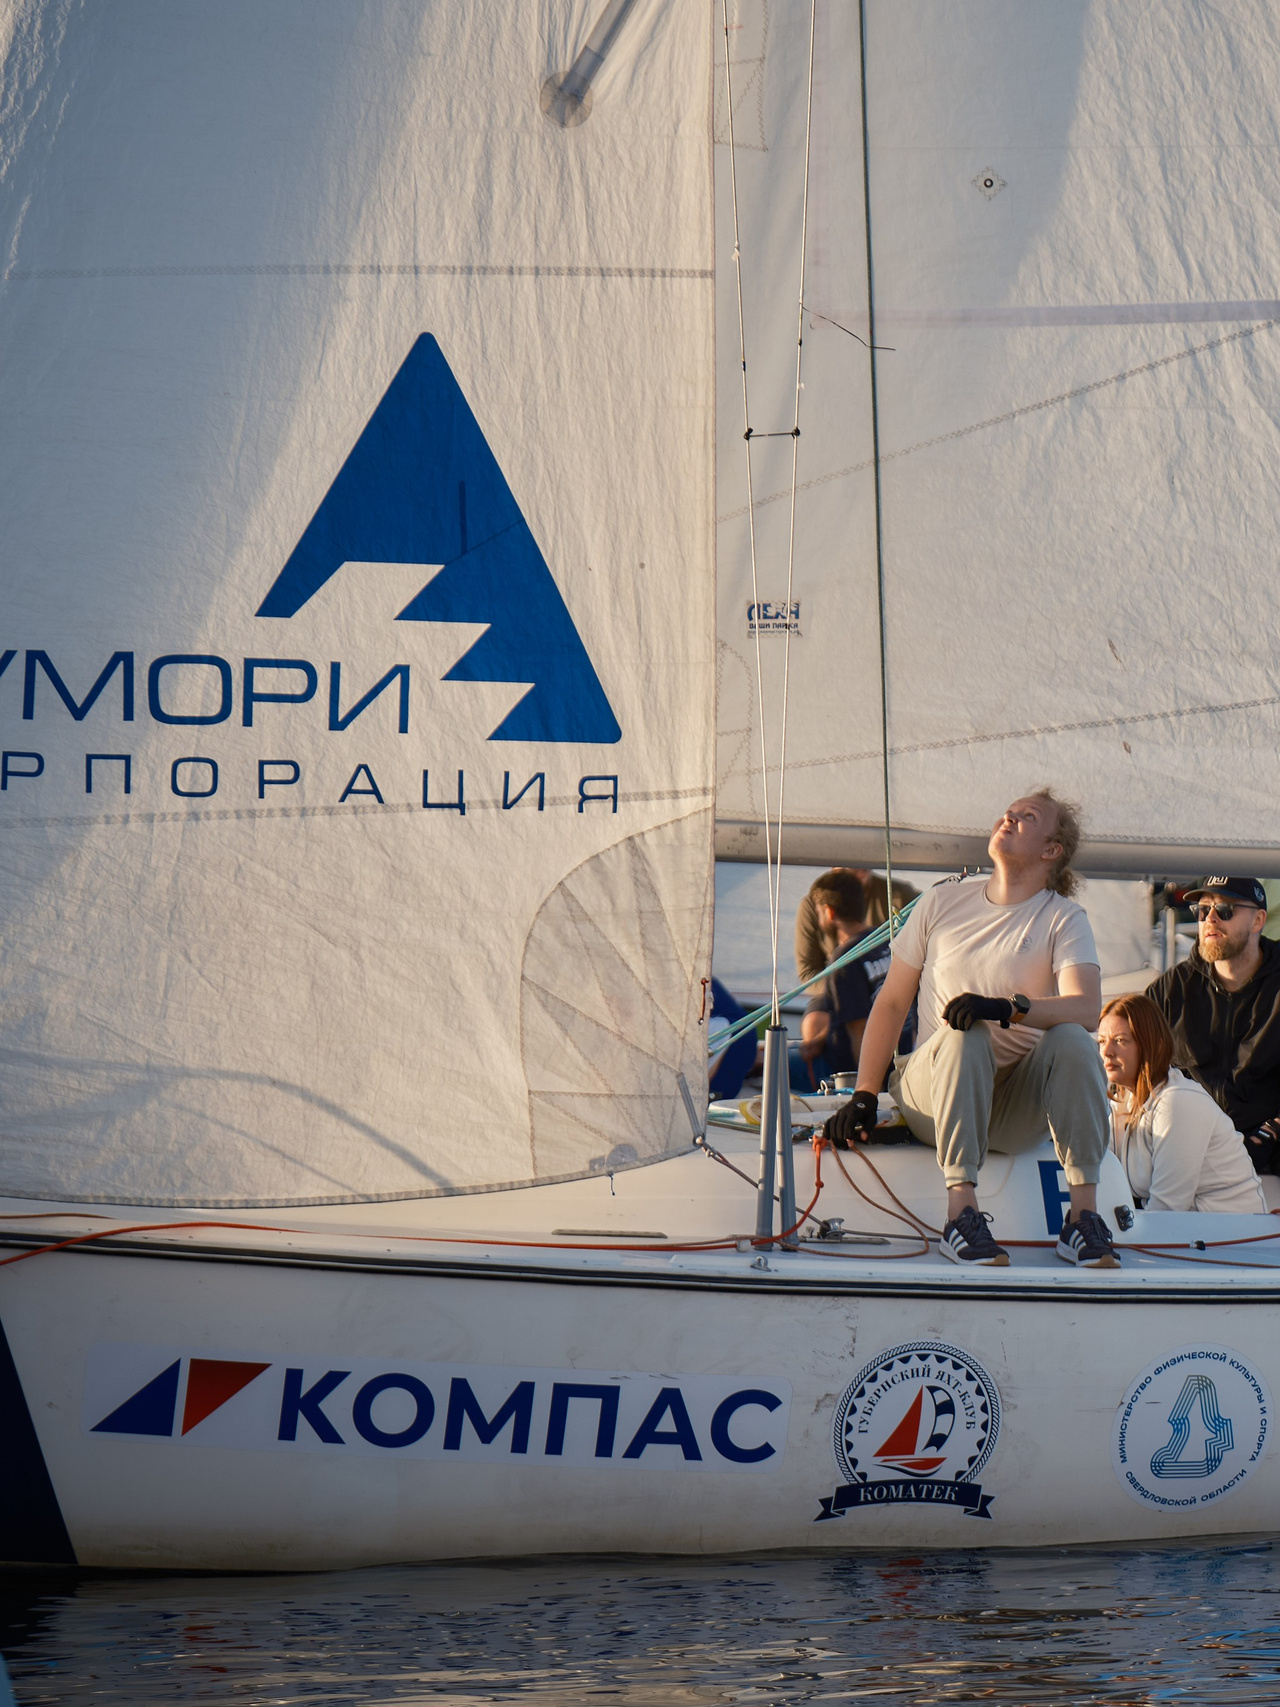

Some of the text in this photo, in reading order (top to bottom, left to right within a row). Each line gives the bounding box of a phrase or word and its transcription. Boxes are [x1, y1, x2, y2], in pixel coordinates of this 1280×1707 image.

[1, 750, 619, 815] РПОРАЦИЯ
[277, 1367, 783, 1464] КОМПАС
[858, 1364, 976, 1434] ГУБЕРНСКИЙ ЯХТ-КЛУБ
[1118, 1351, 1268, 1463] МИНИСТЕРСТВО ФИЗИЧЕСКОЙ КУЛЬТУРЫ И СПОРТА
[859, 1483, 959, 1502] КОМАТЕК
[1125, 1468, 1247, 1506] СВЕРДЛОВСКОЙ ОБЛАСТИ
